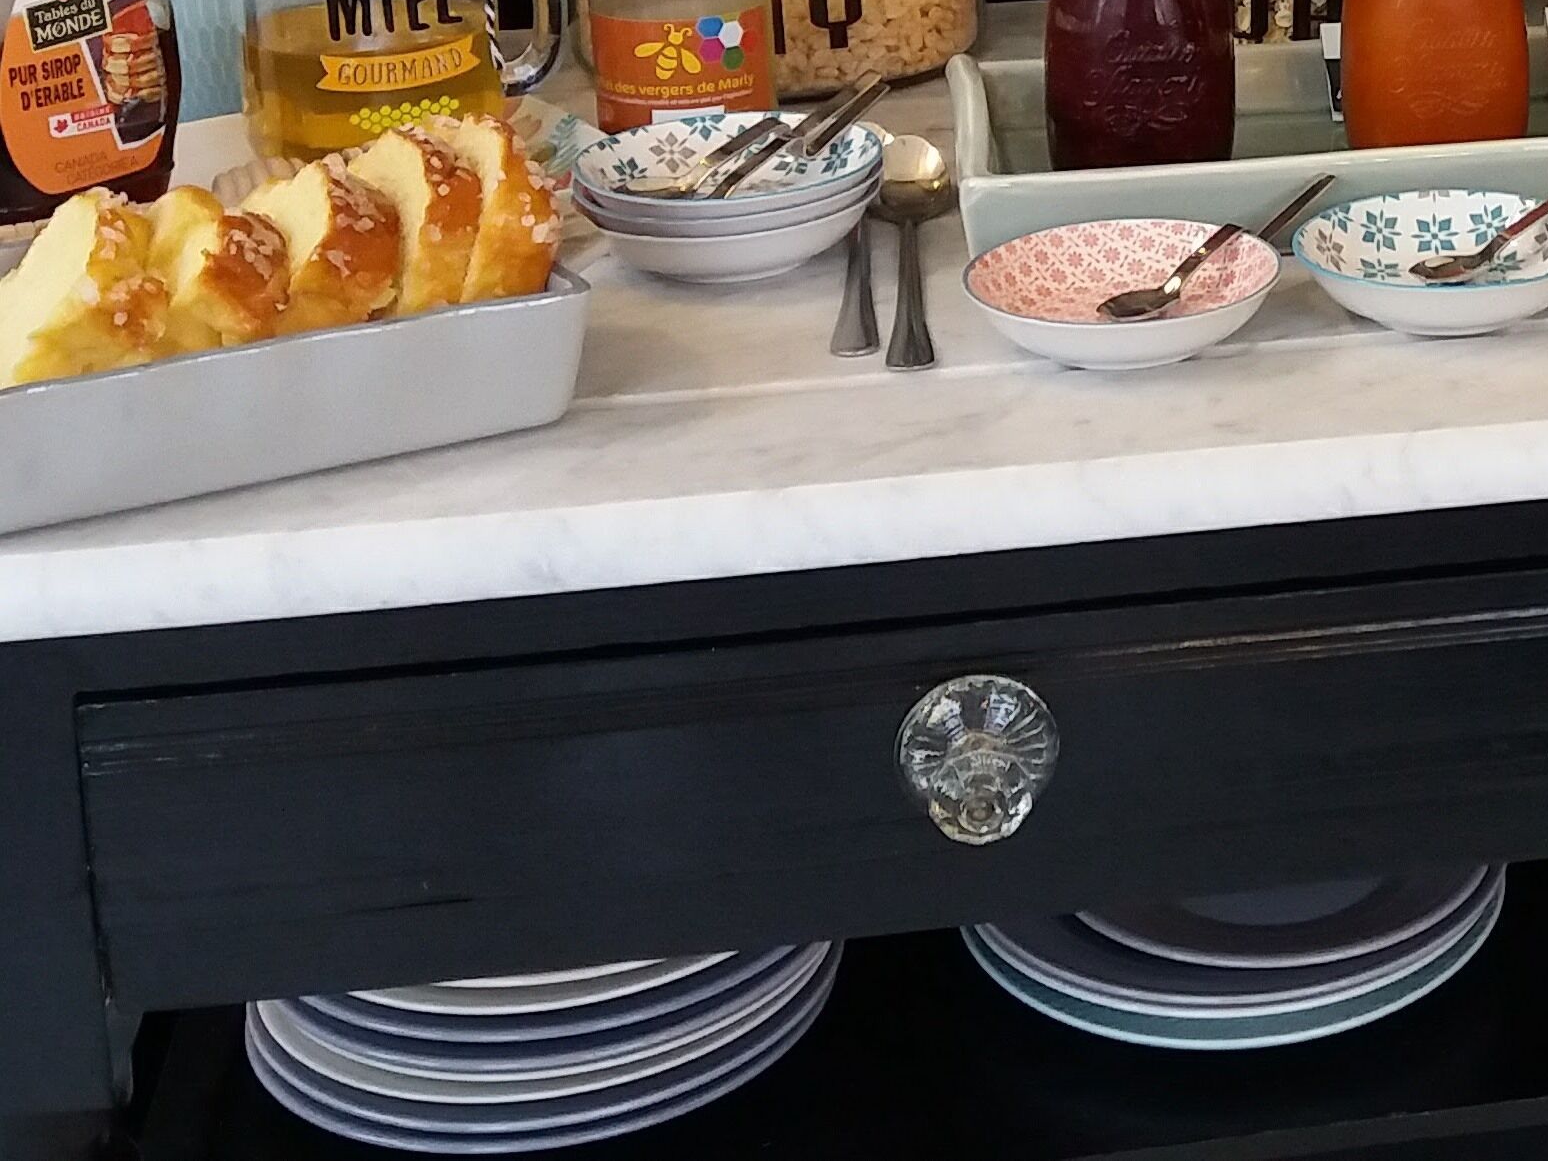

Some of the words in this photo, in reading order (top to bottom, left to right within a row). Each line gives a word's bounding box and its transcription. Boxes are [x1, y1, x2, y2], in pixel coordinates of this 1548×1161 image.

[34, 3, 79, 24] Tables
[34, 8, 104, 44] MONDE
[8, 63, 38, 88] PUR
[42, 53, 82, 81] SIROP
[337, 47, 463, 86] GOURMAND
[614, 81, 636, 96] des
[638, 85, 694, 99] vergers
[697, 81, 716, 94] de
[718, 72, 755, 90] Marly
